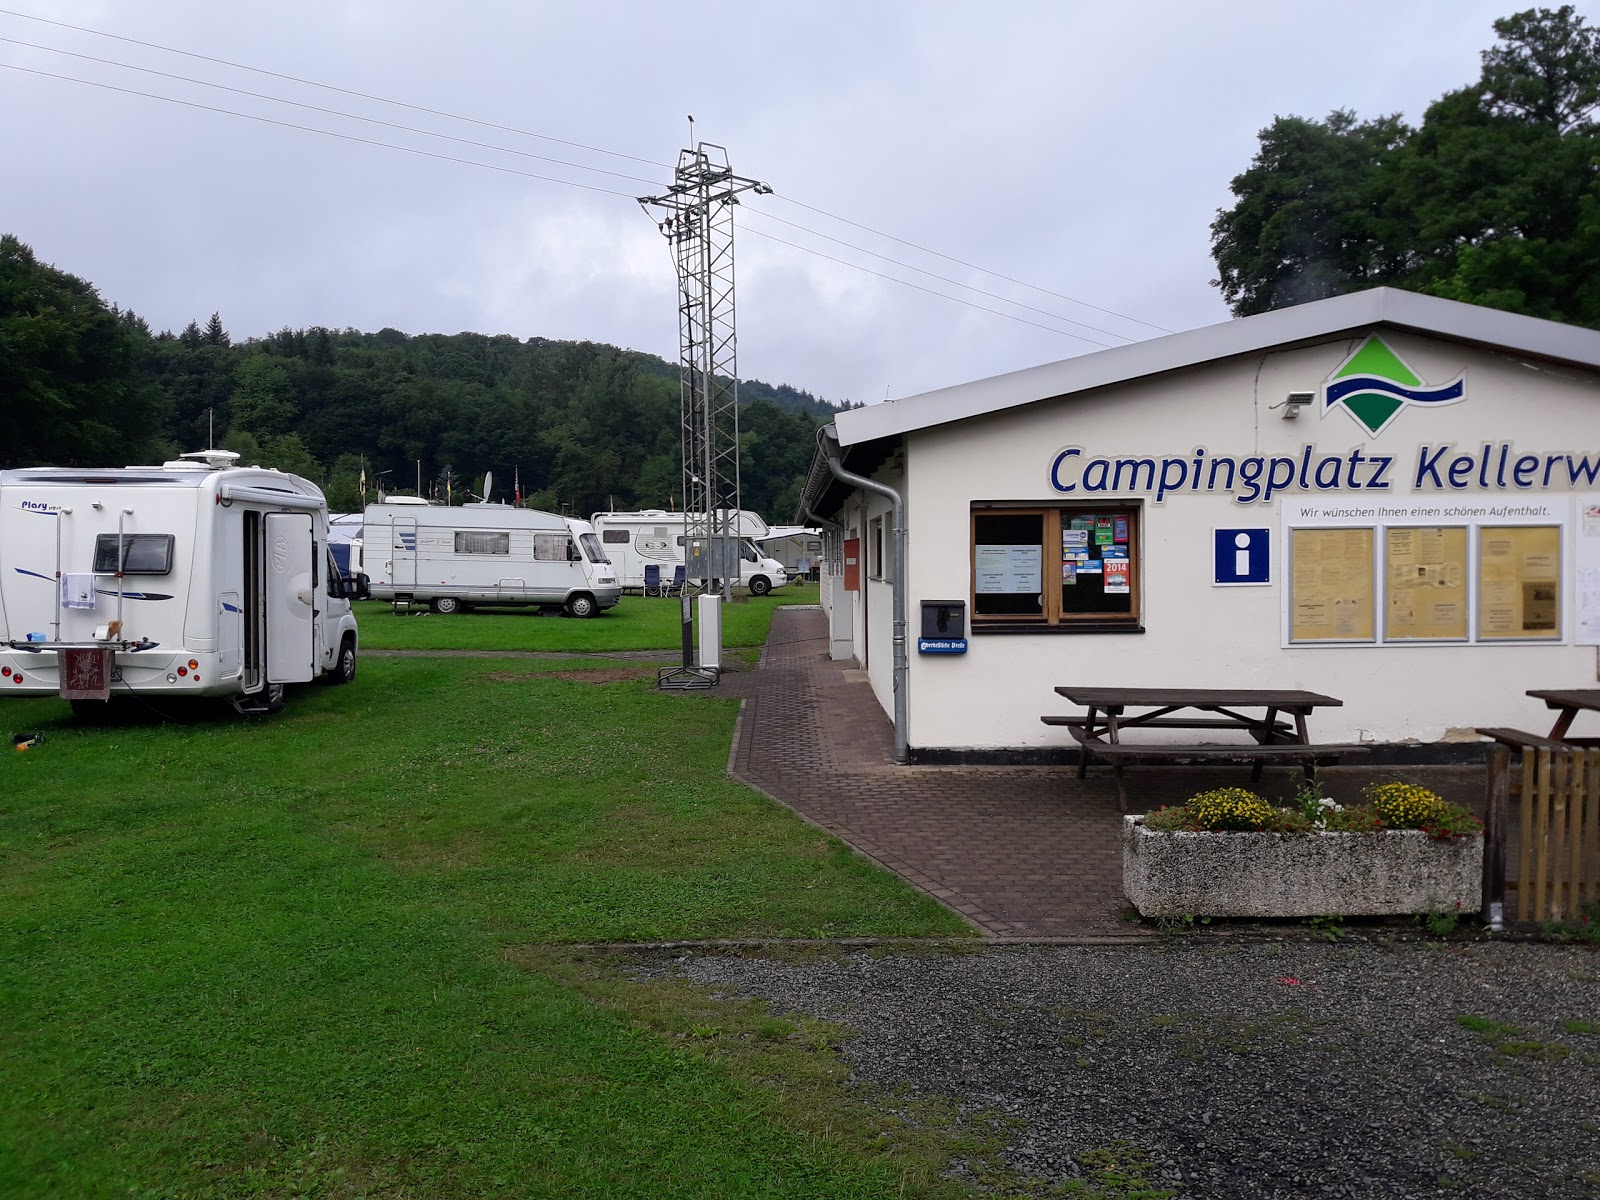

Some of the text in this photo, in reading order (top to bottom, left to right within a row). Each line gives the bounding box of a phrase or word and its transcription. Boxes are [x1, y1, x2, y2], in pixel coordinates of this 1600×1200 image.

[1051, 445, 1600, 503] Campingplatz Kellerw
[1300, 506, 1550, 518] Wir wünschen Ihnen einen schönen Aufenthalt.
[1106, 563, 1127, 572] 2014
